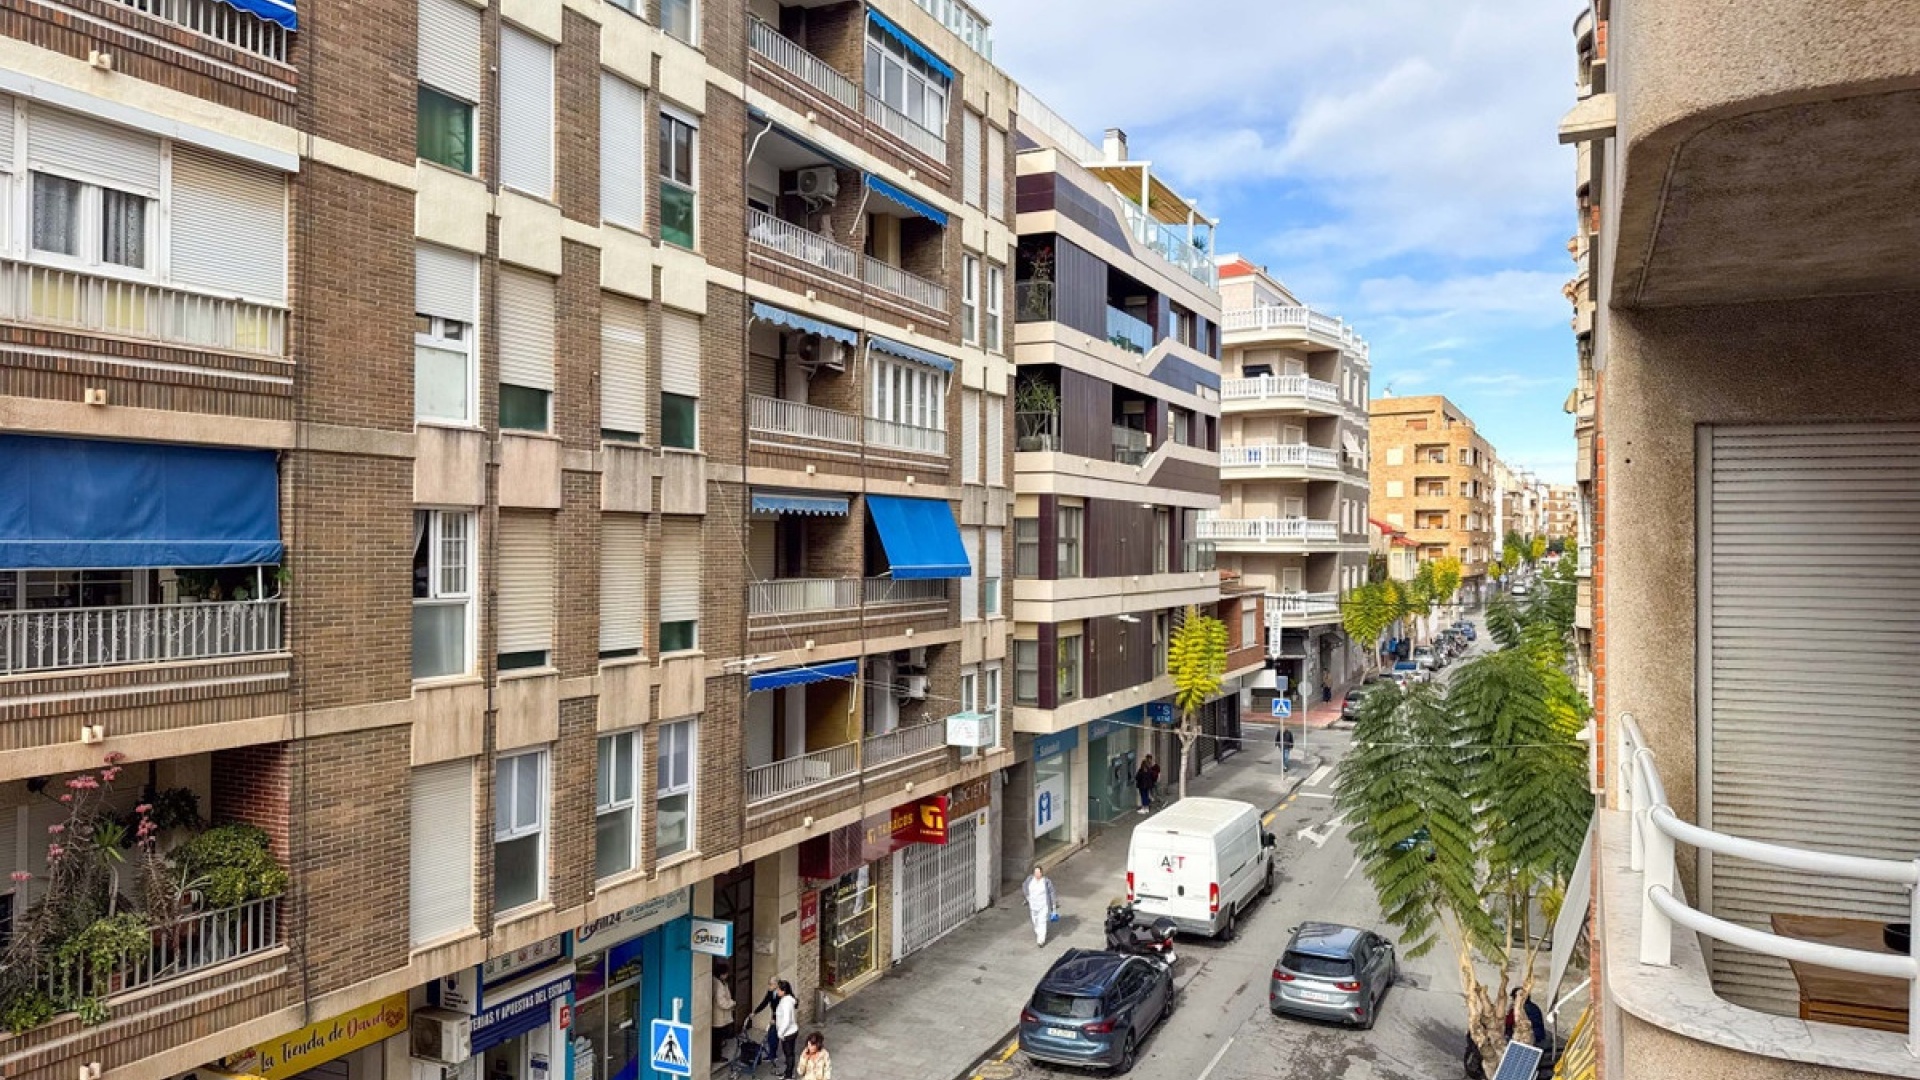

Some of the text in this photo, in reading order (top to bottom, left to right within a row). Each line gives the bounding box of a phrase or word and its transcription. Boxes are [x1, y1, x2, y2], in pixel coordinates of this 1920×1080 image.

[501, 995, 534, 1019] APUESTAS
[533, 989, 547, 1005] DEL
[548, 978, 572, 1000] ESTADO
[260, 1003, 385, 1074] La Tienda de David
